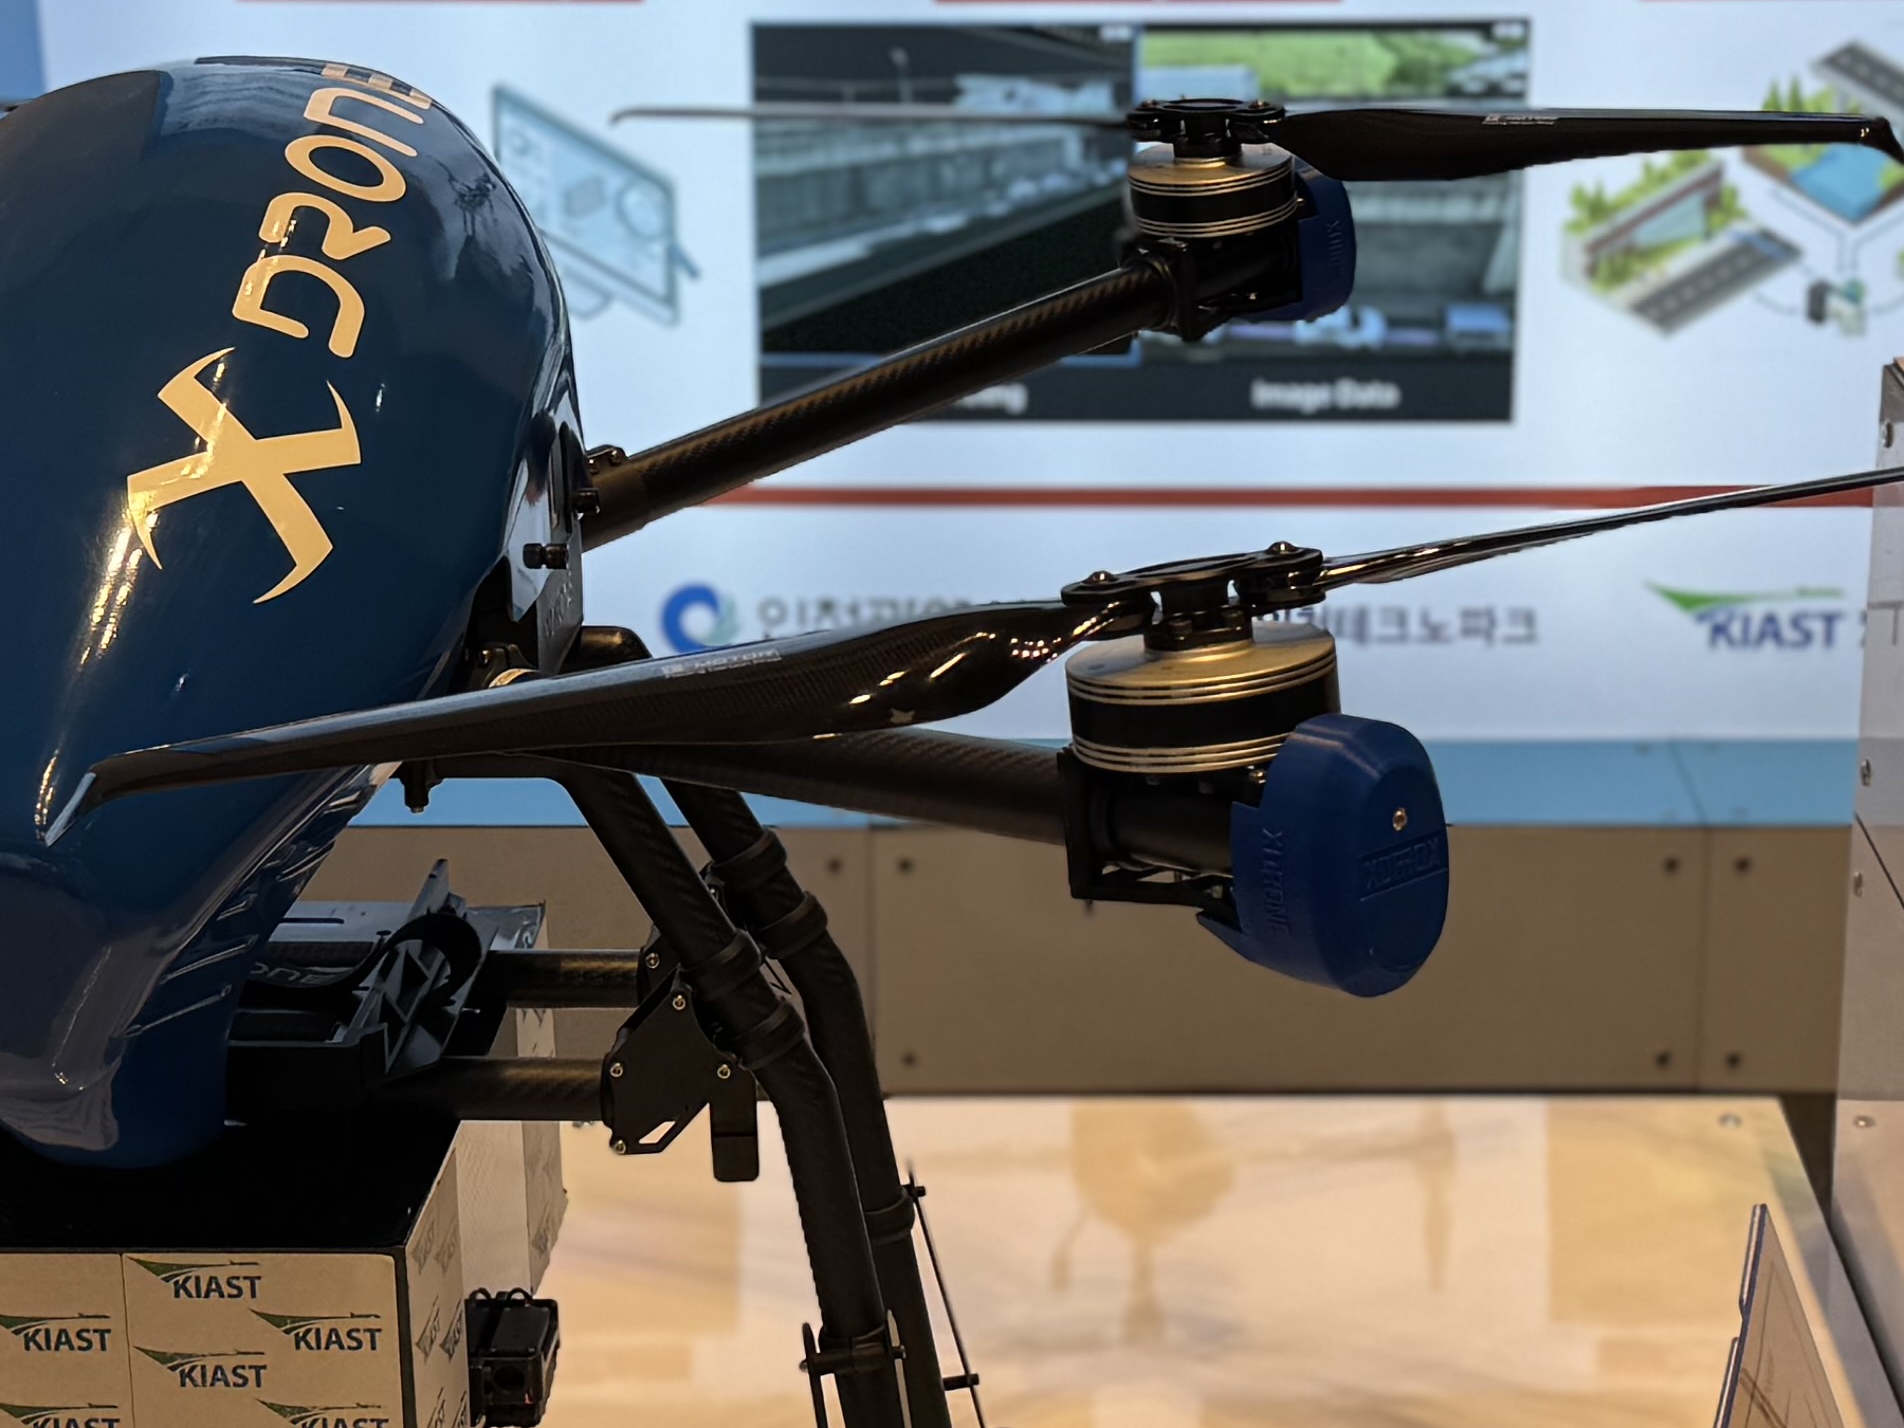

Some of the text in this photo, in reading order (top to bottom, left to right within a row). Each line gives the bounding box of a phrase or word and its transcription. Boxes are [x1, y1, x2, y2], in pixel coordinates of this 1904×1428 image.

[1708, 611, 1842, 649] KIAST
[169, 1275, 262, 1299] KIAST
[17, 1328, 112, 1352] KIAST
[289, 1328, 382, 1351] KIAST
[175, 1364, 267, 1388] KIAST
